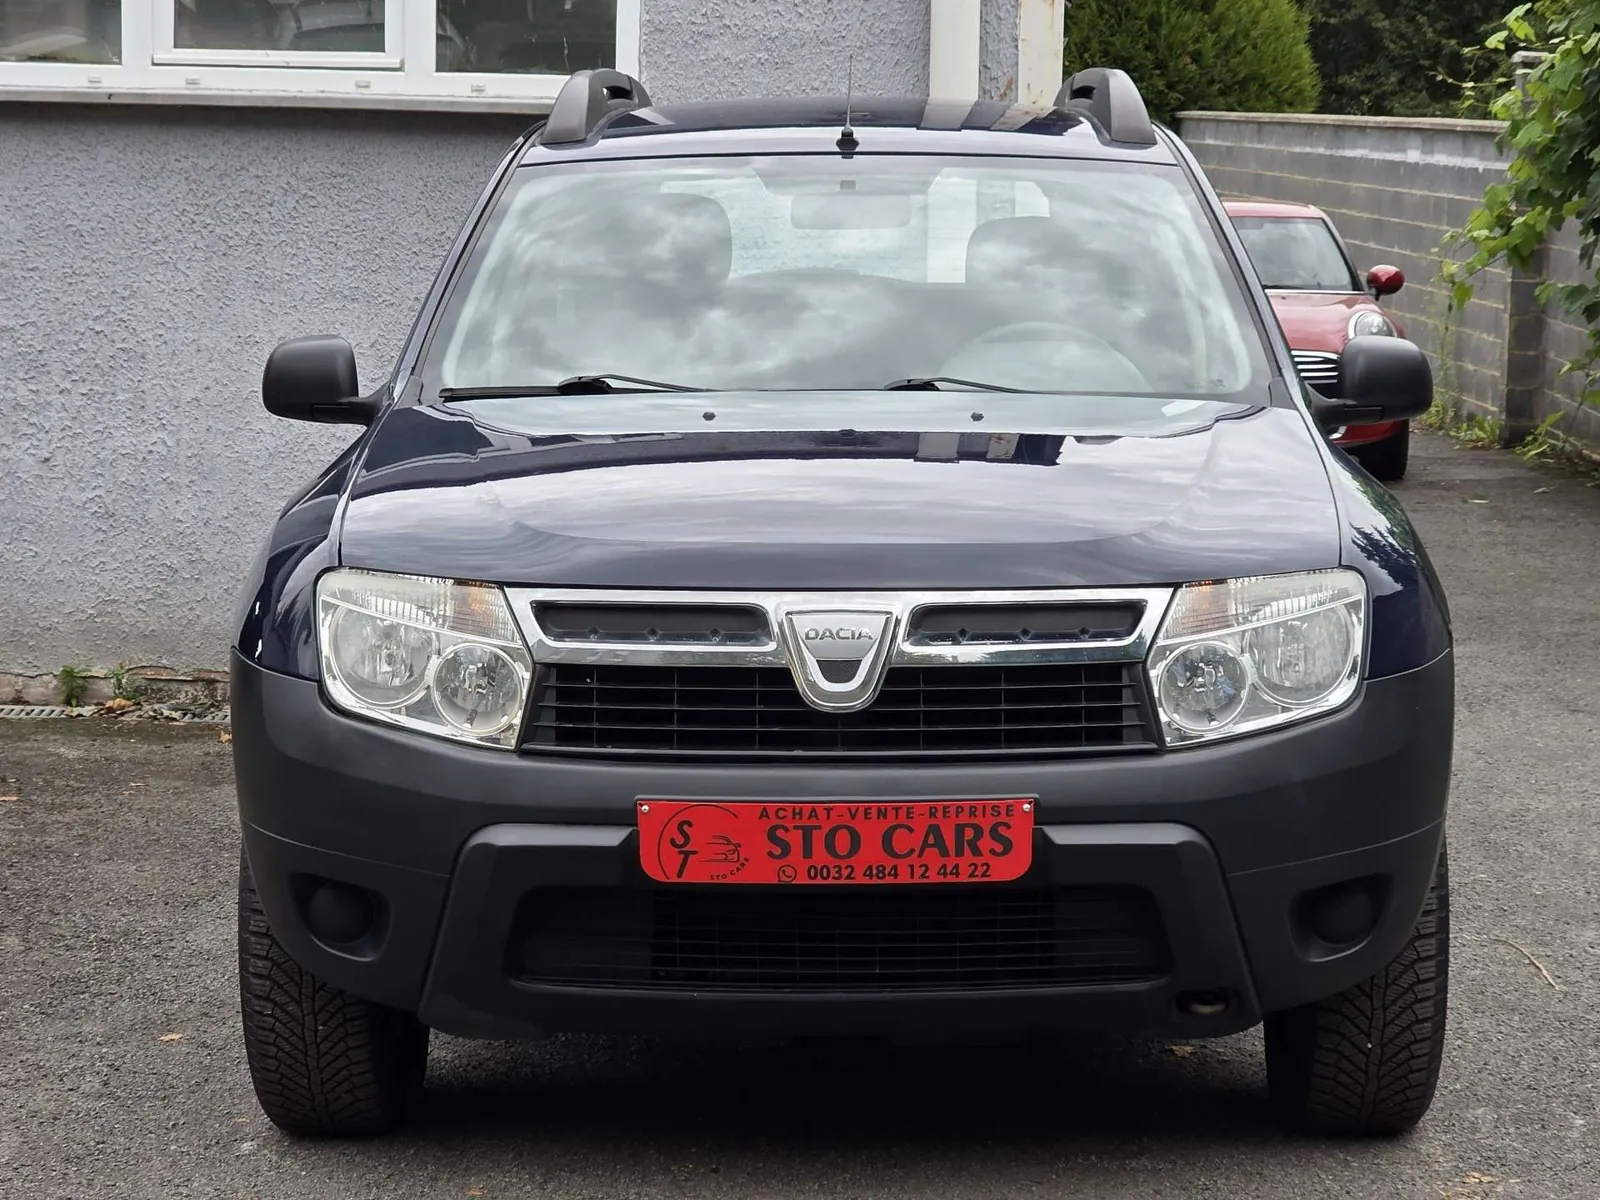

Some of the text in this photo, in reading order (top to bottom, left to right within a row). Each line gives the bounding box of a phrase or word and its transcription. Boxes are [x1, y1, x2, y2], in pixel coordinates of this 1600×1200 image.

[804, 627, 874, 641] DACIA
[758, 803, 1015, 821] ACHAT-VENTE-REPRISE
[766, 820, 1014, 861] STO CARS
[806, 862, 991, 881] 0032 484 12 44 22
